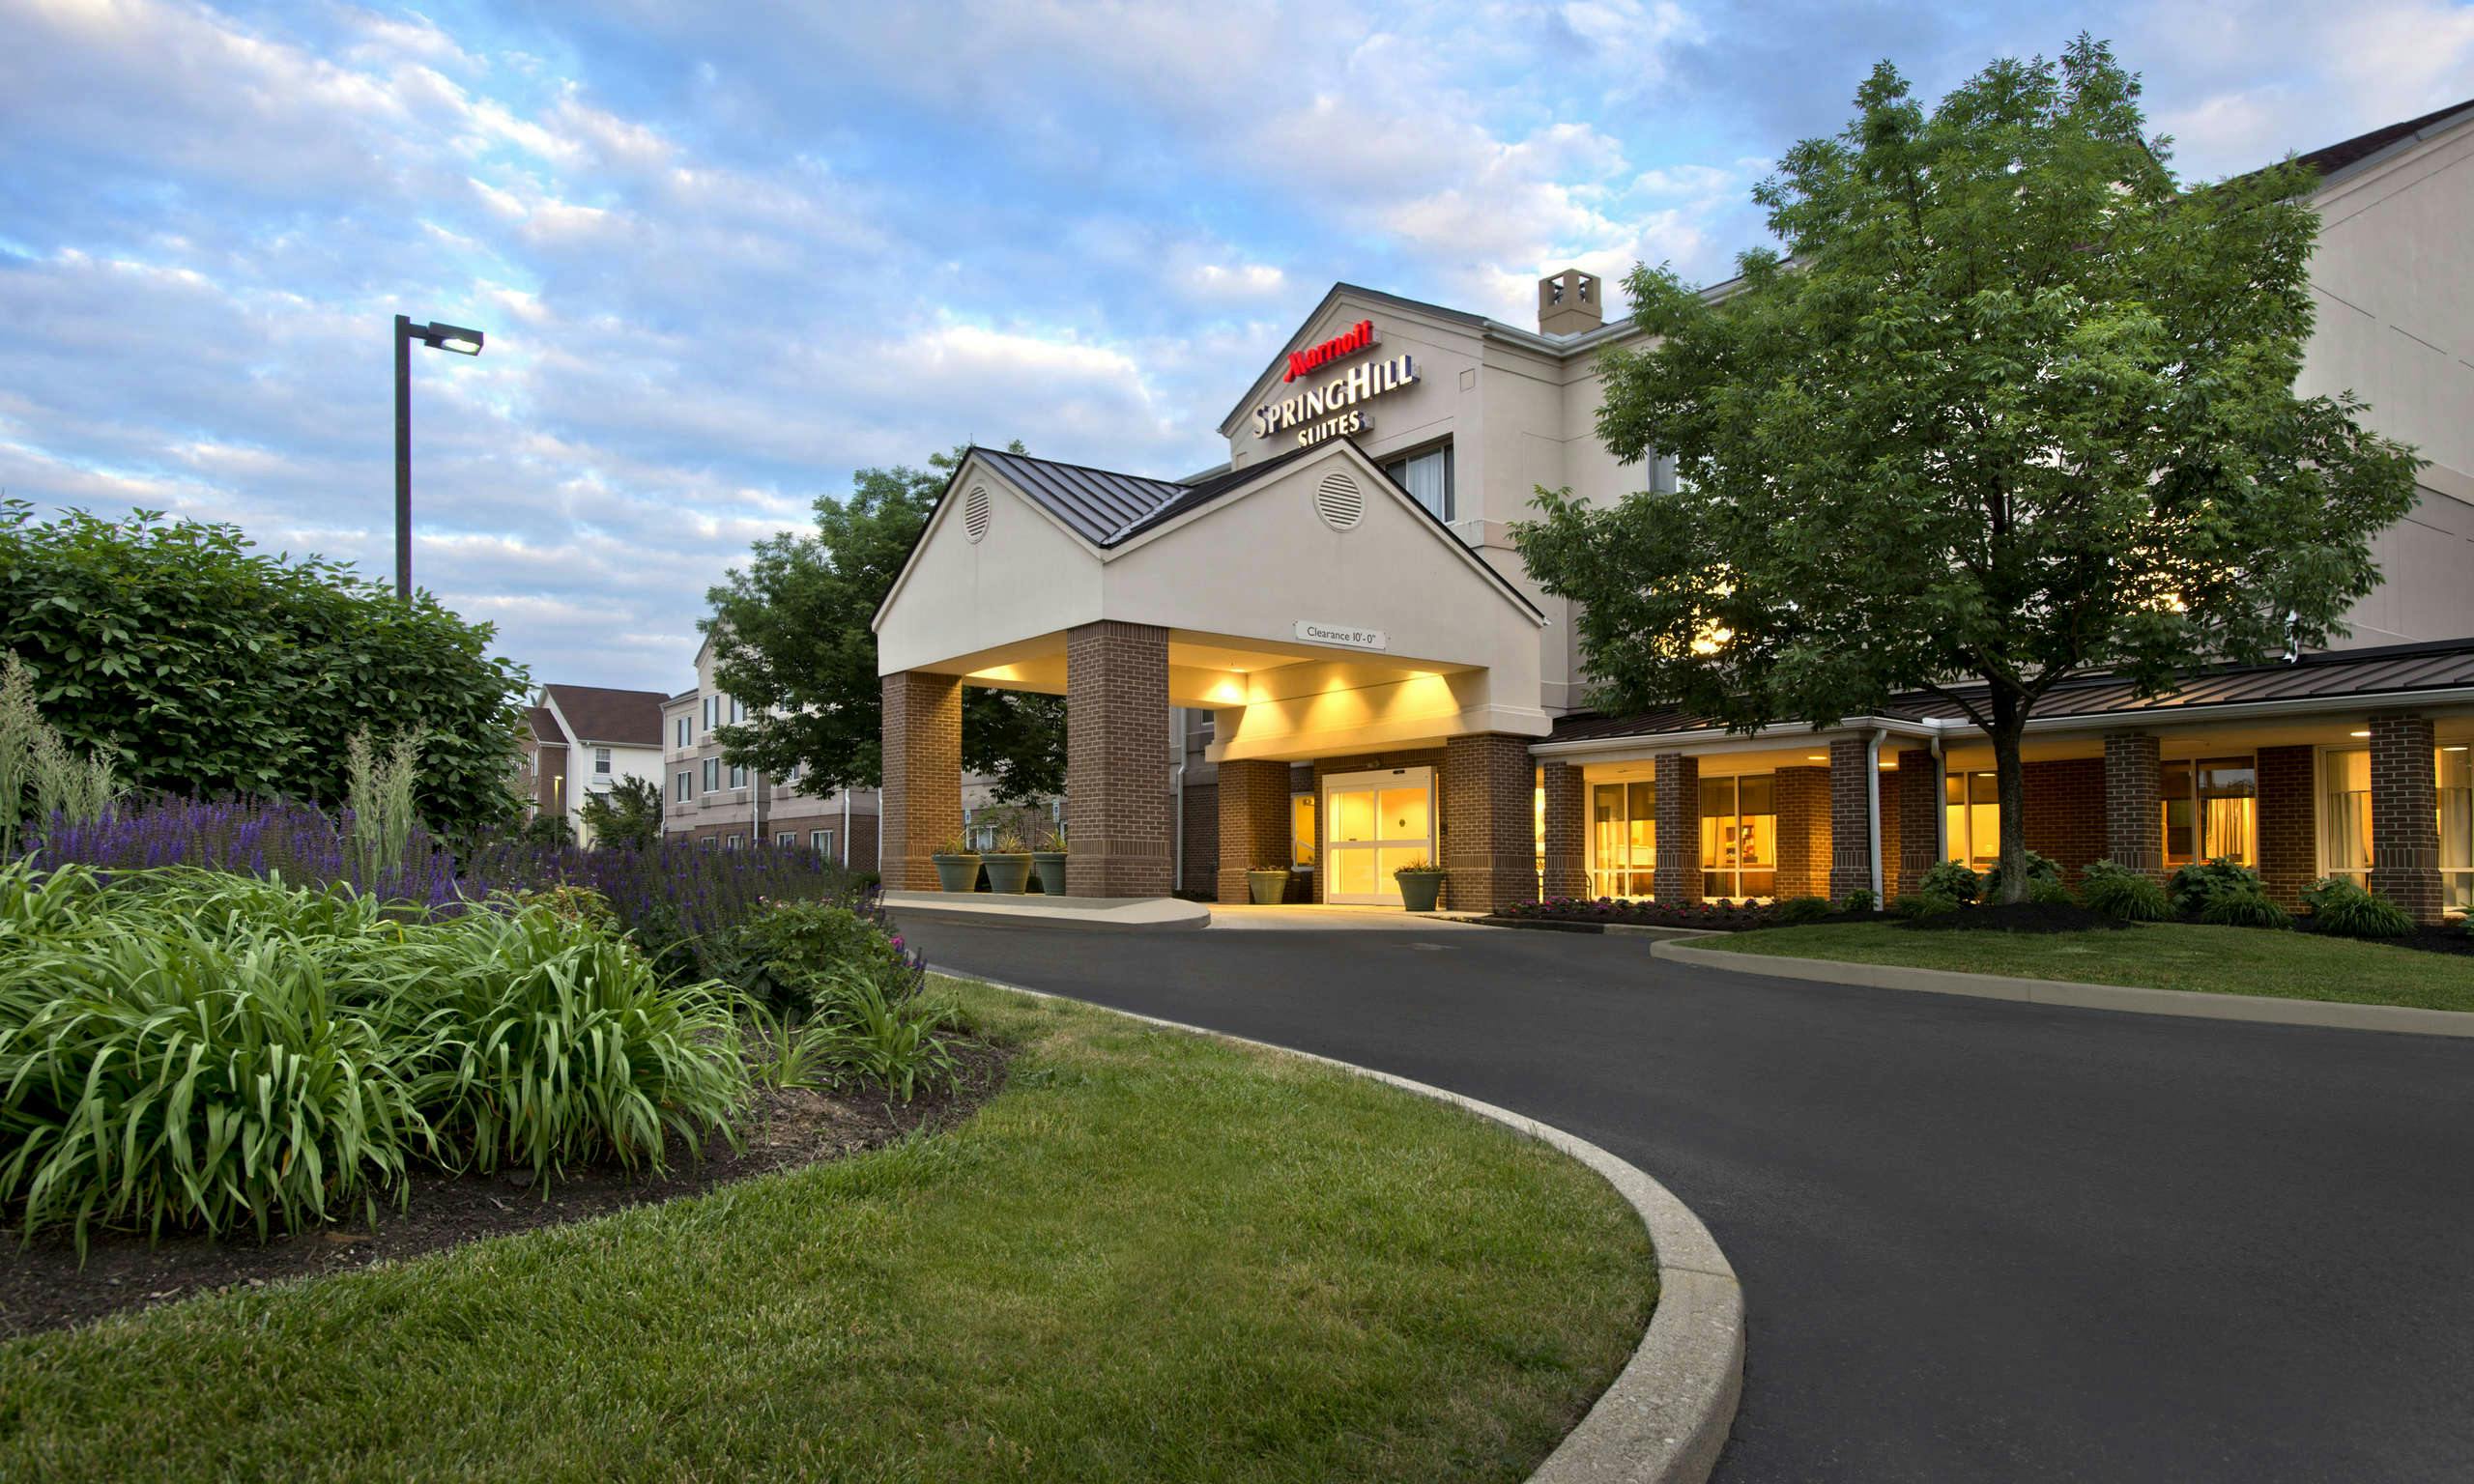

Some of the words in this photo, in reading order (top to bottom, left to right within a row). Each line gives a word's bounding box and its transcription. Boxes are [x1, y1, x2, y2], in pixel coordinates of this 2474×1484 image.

[1283, 320, 1373, 383] Marriott
[1298, 411, 1360, 448] SUITES
[1307, 626, 1350, 642] Clearance
